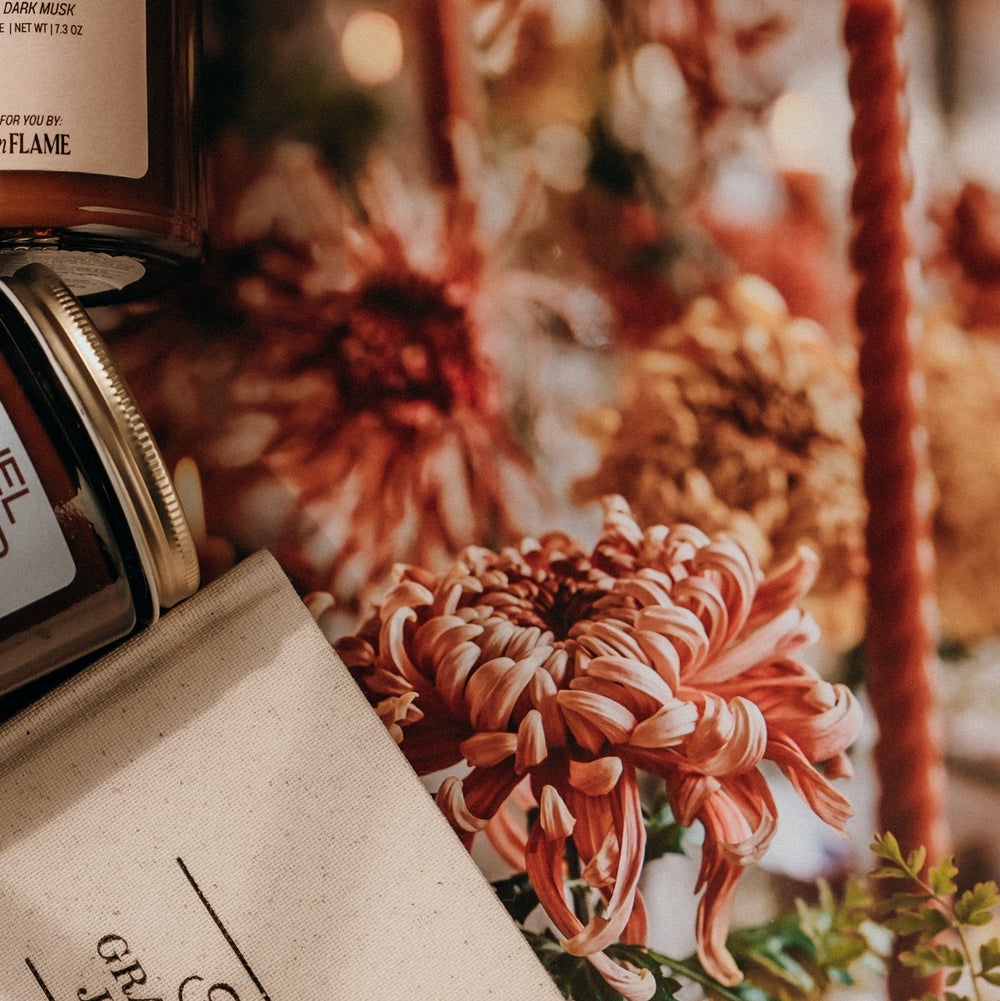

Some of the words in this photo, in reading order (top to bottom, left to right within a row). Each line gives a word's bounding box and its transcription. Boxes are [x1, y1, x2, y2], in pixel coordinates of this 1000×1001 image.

[3, 2, 38, 14] DARK
[39, 2, 76, 16] MUSK
[14, 23, 31, 33] NET
[34, 23, 48, 34] WT
[55, 24, 68, 34] 7.3
[70, 24, 83, 36] OZ
[0, 115, 20, 126] FOR
[23, 116, 44, 126] YOU
[46, 116, 62, 127] BY:
